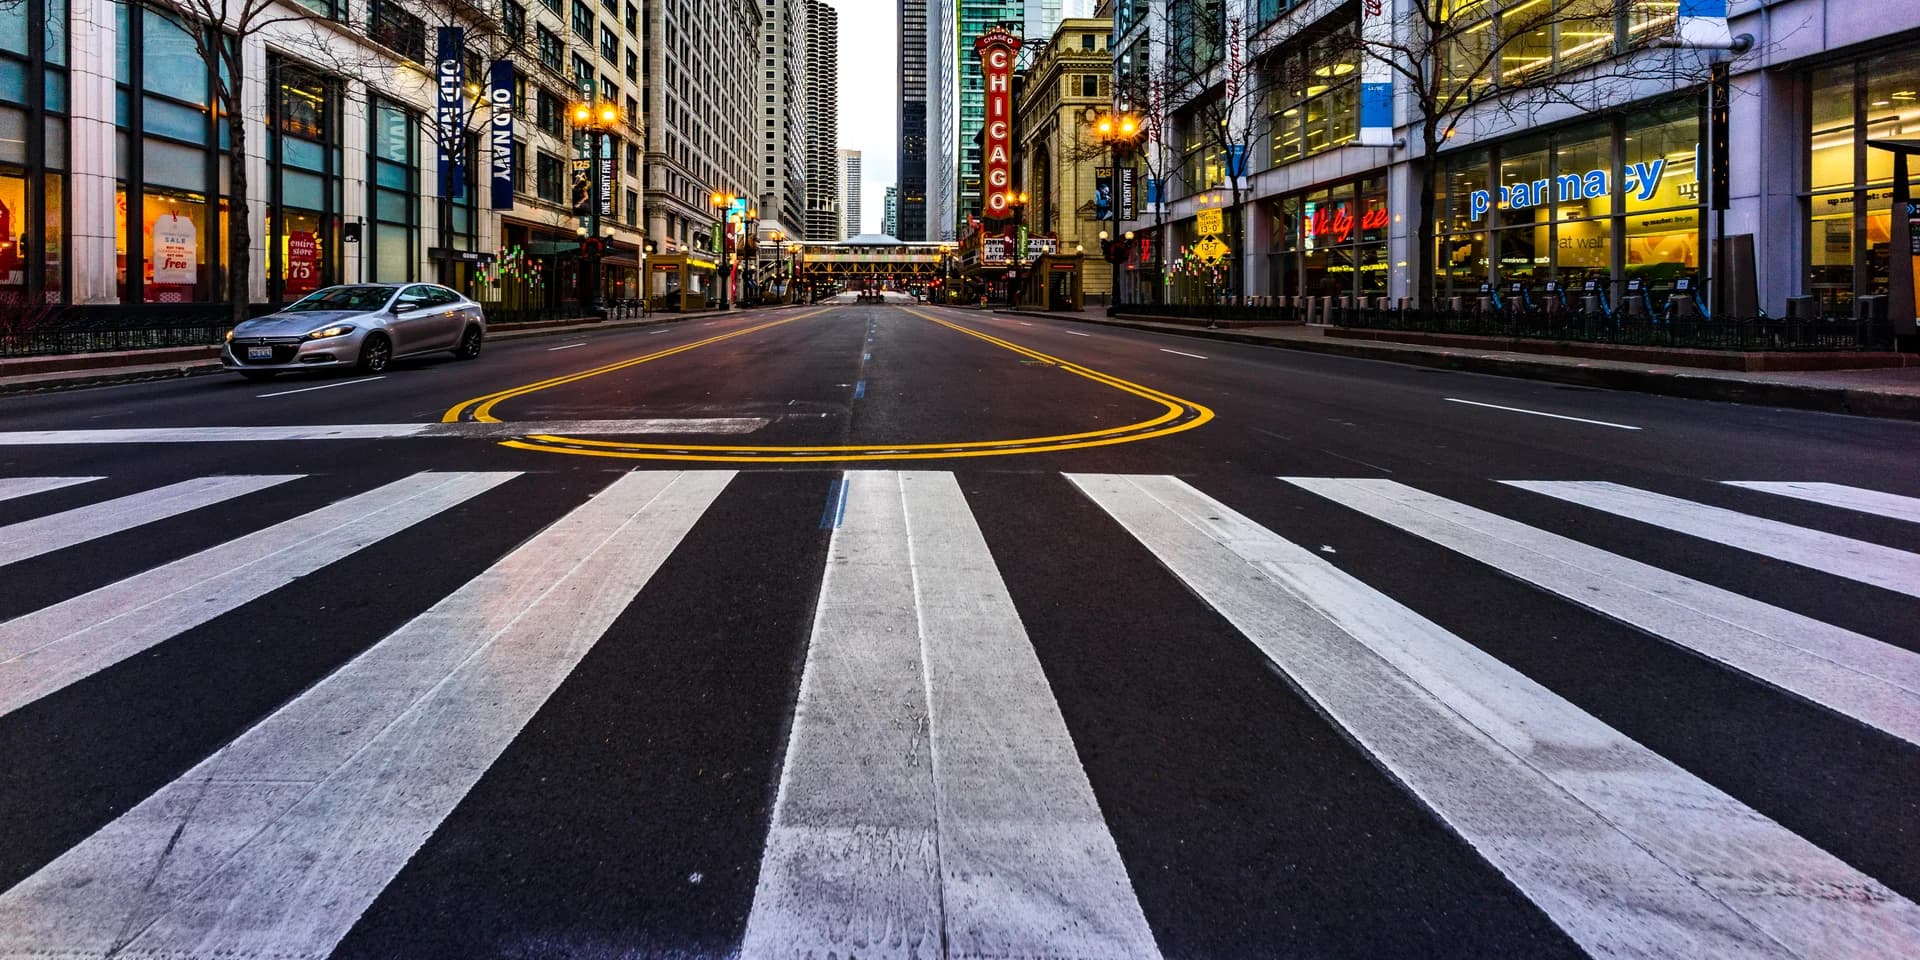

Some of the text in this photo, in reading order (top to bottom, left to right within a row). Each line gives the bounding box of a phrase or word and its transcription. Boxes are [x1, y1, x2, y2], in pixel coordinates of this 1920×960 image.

[984, 35, 1008, 44] CHASE
[493, 88, 511, 181] OLD NAVY
[990, 50, 1008, 210] CHICAGO
[573, 160, 590, 169] 125
[1096, 169, 1112, 177] 125
[602, 160, 611, 215] ONE TWENTY FIVE
[1123, 168, 1132, 220] ONE TWENTY FIVE
[1312, 207, 1390, 242] Walgee
[290, 239, 315, 249] entire
[1576, 235, 1604, 249] well
[293, 248, 313, 256] store
[162, 258, 187, 270] free
